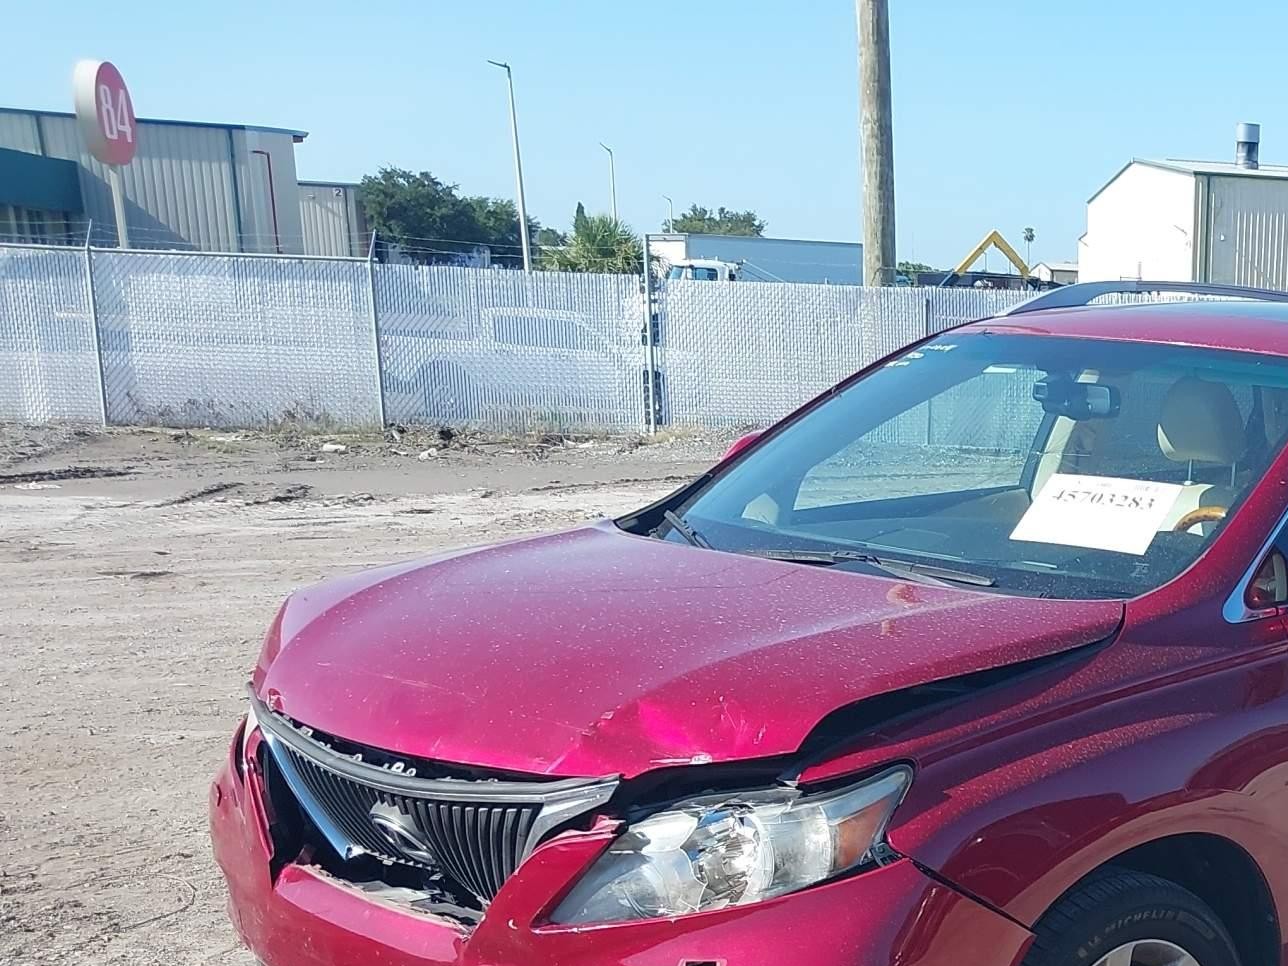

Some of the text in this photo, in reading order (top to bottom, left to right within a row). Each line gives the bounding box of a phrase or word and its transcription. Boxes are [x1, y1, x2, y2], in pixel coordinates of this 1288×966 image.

[100, 84, 132, 143] 84
[335, 188, 342, 197] 2
[1051, 488, 1157, 511] 45703283
